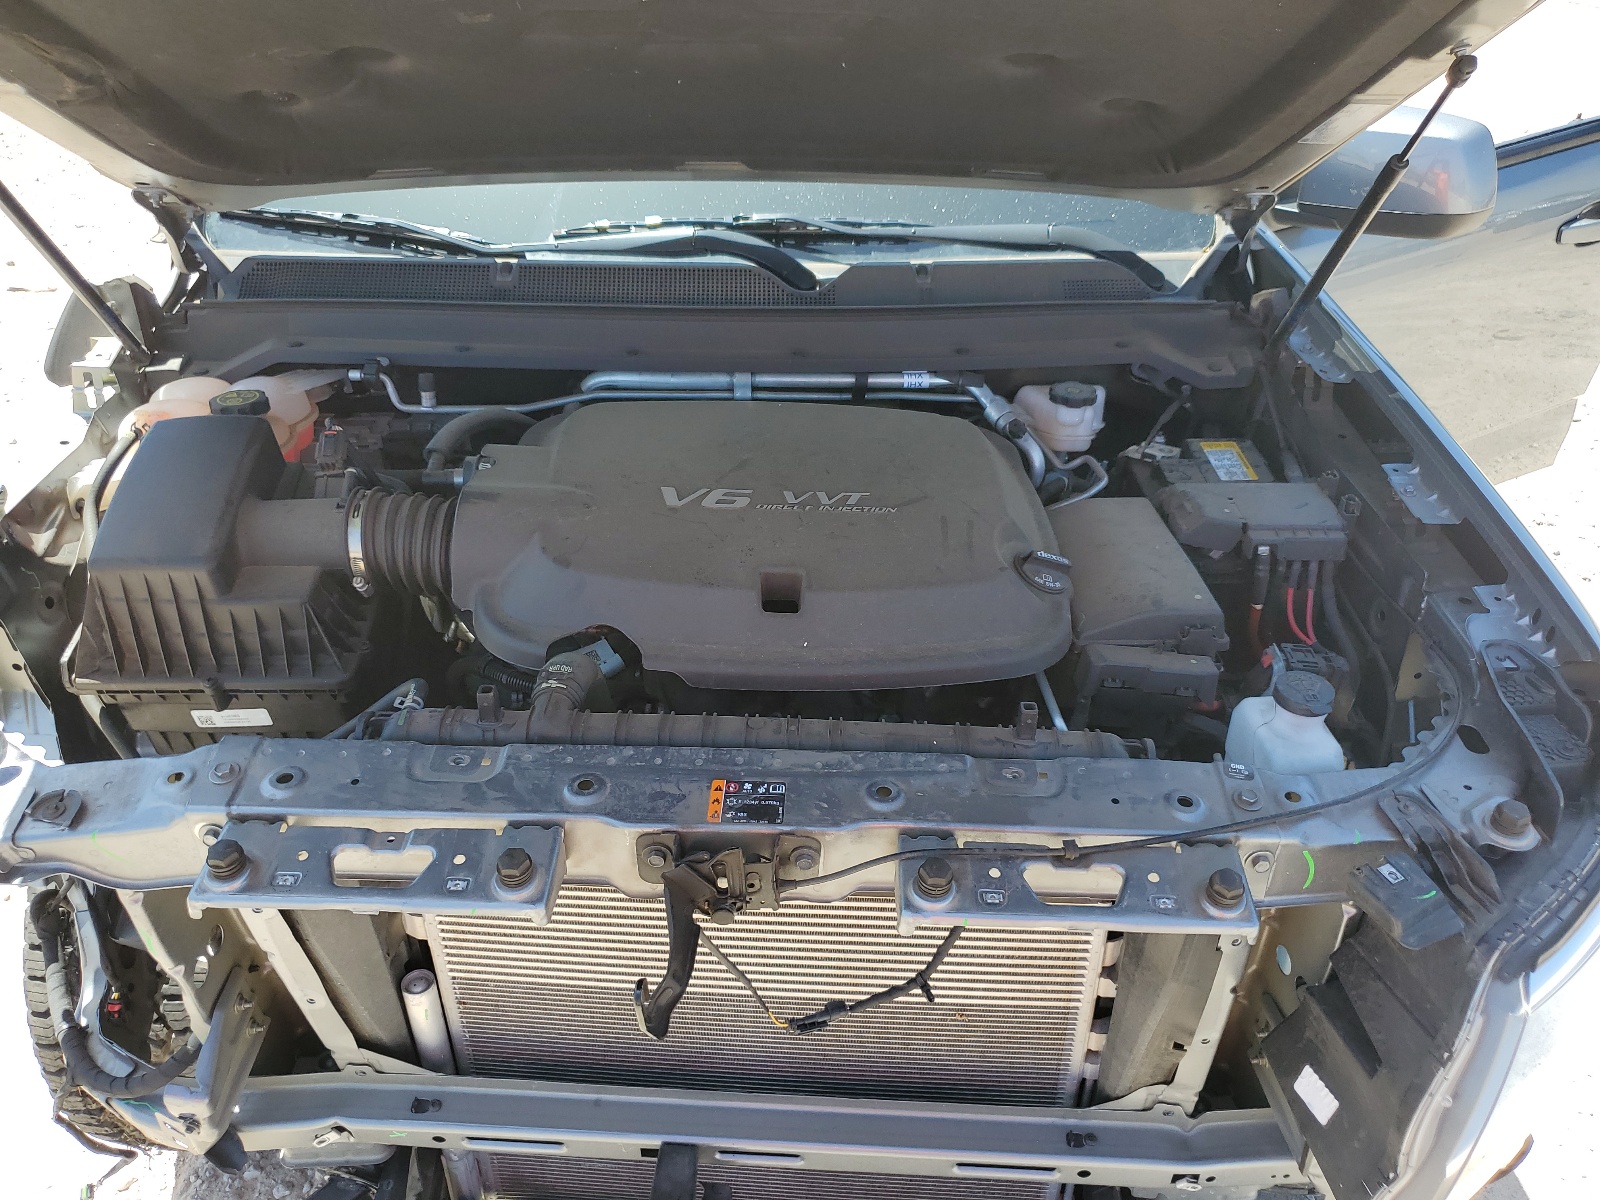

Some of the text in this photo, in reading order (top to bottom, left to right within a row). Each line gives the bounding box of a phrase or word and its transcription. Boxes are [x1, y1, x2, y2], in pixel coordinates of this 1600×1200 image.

[660, 486, 754, 508] V6
[783, 490, 870, 505] VVT
[818, 505, 898, 513] INJECTION
[1036, 550, 1070, 565] dexos
